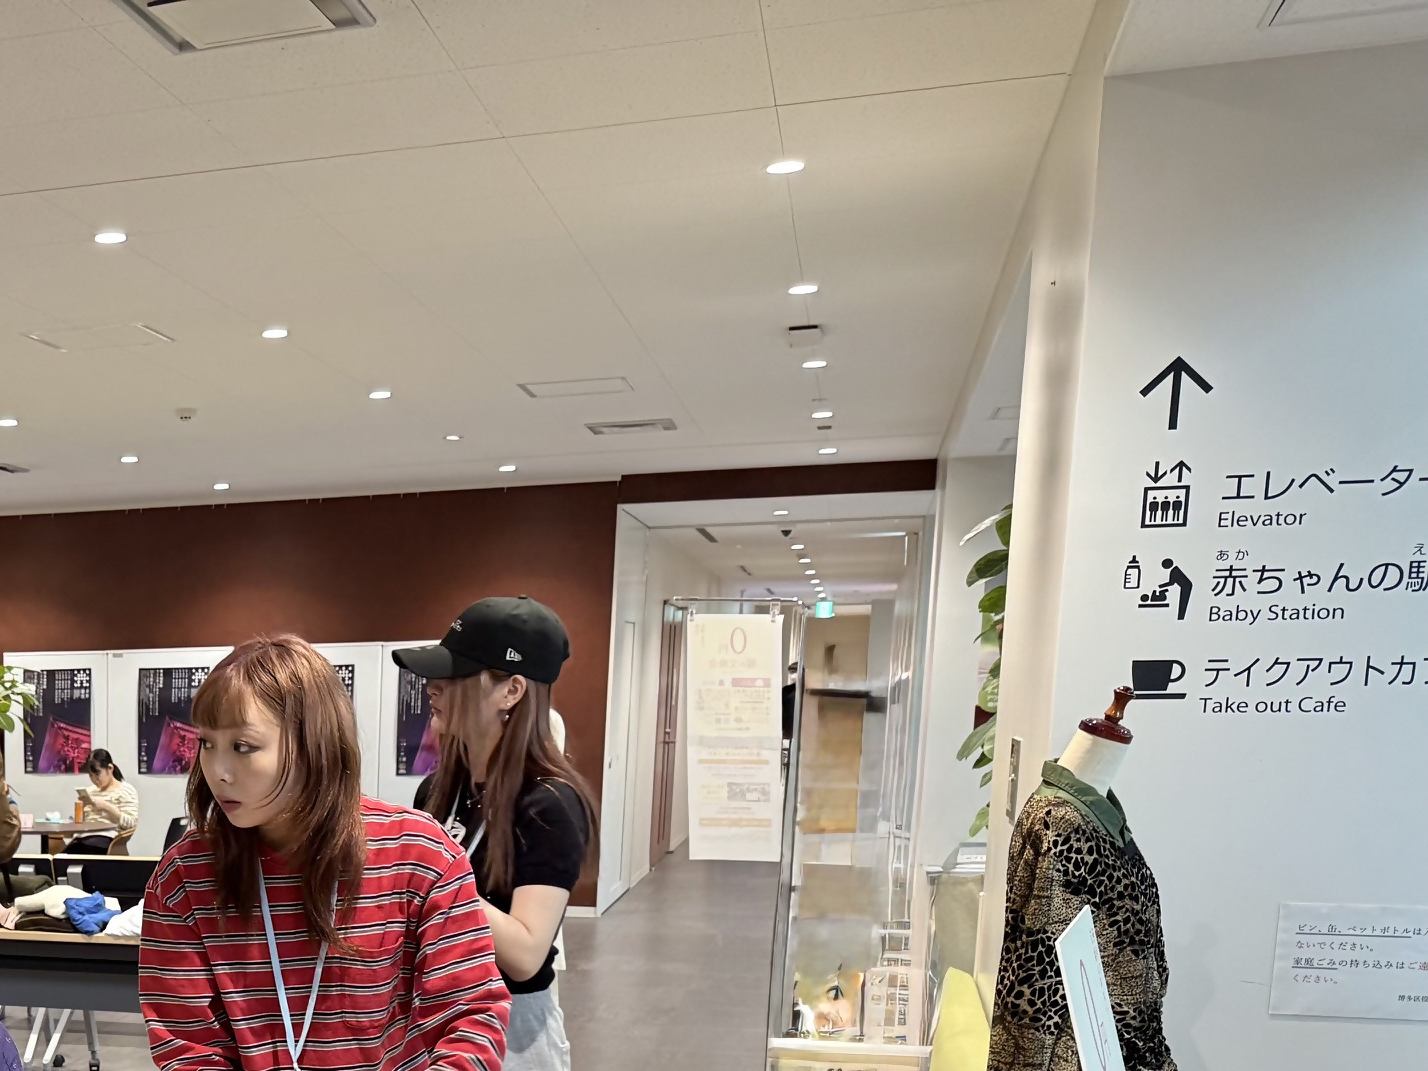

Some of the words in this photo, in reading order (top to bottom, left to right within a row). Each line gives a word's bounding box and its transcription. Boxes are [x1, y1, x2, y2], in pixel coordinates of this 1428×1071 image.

[1221, 464, 1428, 501] エレベータ
[1217, 510, 1307, 528] Elevator
[1208, 604, 1262, 626] Baby
[1267, 603, 1345, 621] Station
[1204, 654, 1428, 688] テイクアウトカ
[1199, 696, 1249, 714] Take
[1254, 698, 1292, 714] out
[1298, 695, 1347, 713] Cafe
